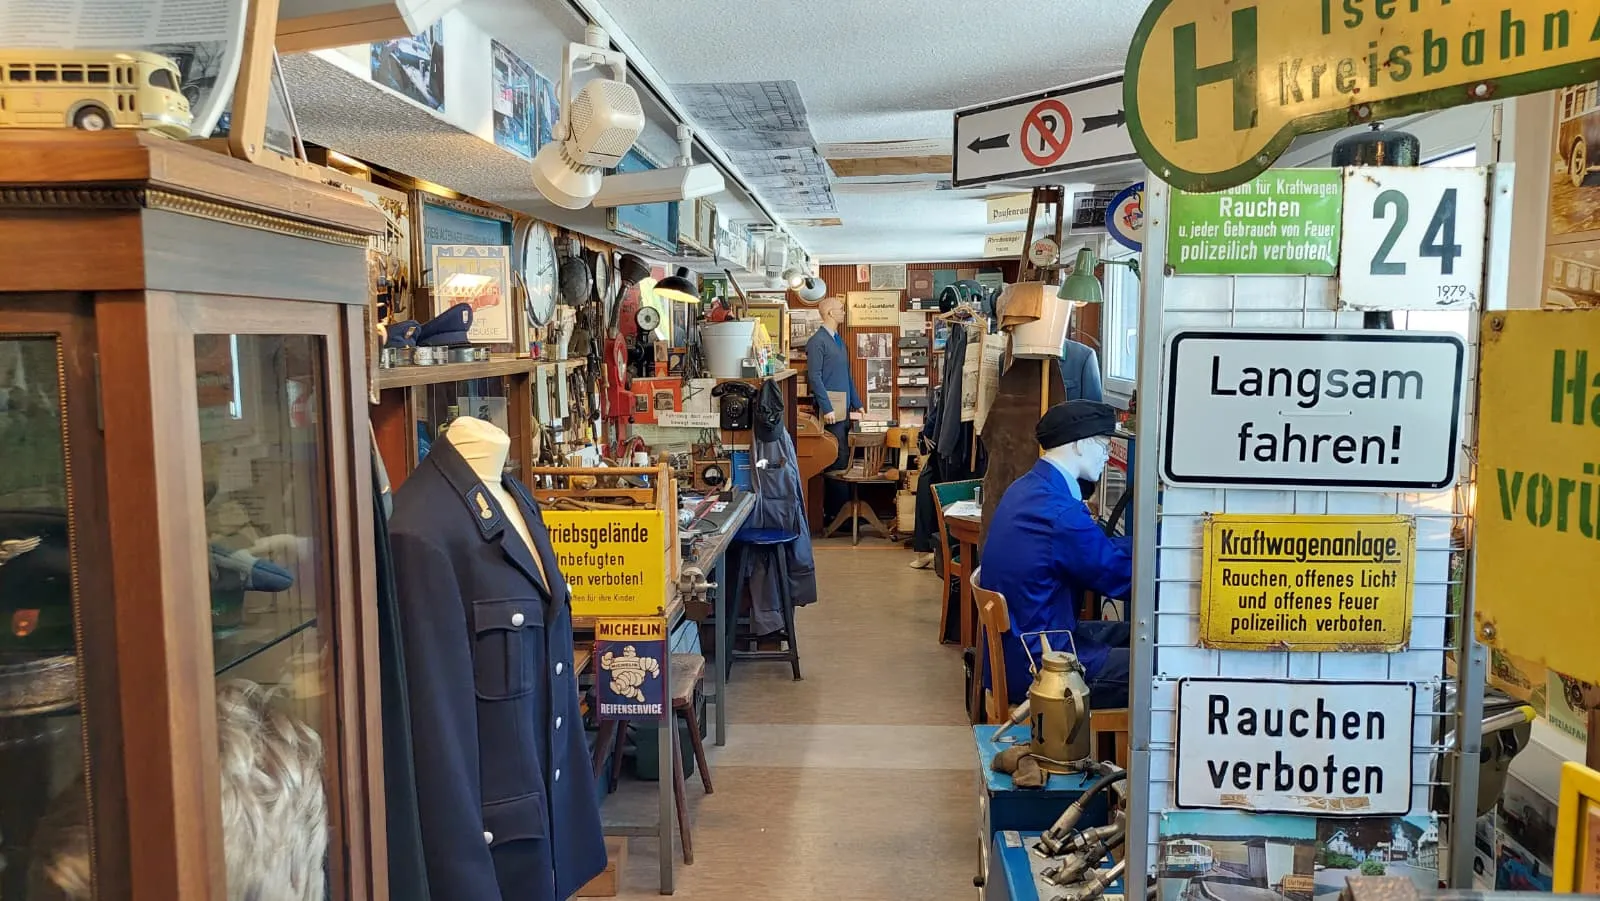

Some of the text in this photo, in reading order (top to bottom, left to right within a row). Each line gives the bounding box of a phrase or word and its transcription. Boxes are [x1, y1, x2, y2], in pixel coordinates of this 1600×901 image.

[1279, 8, 1569, 106] Kreisbahn
[1173, 5, 1258, 142] H
[1256, 179, 1271, 195] für
[1277, 179, 1337, 198] Kraftwagen
[1219, 196, 1300, 218] Rauchen
[1189, 221, 1219, 240] jeder
[1223, 220, 1277, 238] Gebrauch
[1282, 225, 1299, 237] von
[1304, 221, 1335, 238] Feuer
[1369, 187, 1462, 276] 24
[1180, 240, 1332, 263] polizeilich verboten!
[1437, 285, 1466, 297] 1979
[1210, 355, 1424, 409] Langsam
[1237, 422, 1402, 465] fahren!
[546, 522, 648, 550] triebsgelände
[1220, 528, 1401, 563] Kraftwagenanlage.
[565, 571, 644, 586] ten verboten!
[1222, 568, 1397, 588] Rauchen, offenes Licht
[587, 594, 597, 602] für
[614, 594, 635, 602] Kinder
[1238, 592, 1379, 611] und offenes Feuer
[599, 623, 661, 636] MICHELIN
[1230, 613, 1387, 635] polizeilich verboten.
[600, 703, 662, 715] REIFENSERVICE
[1207, 694, 1385, 740] Rauchen
[1206, 750, 1384, 795] verboten
